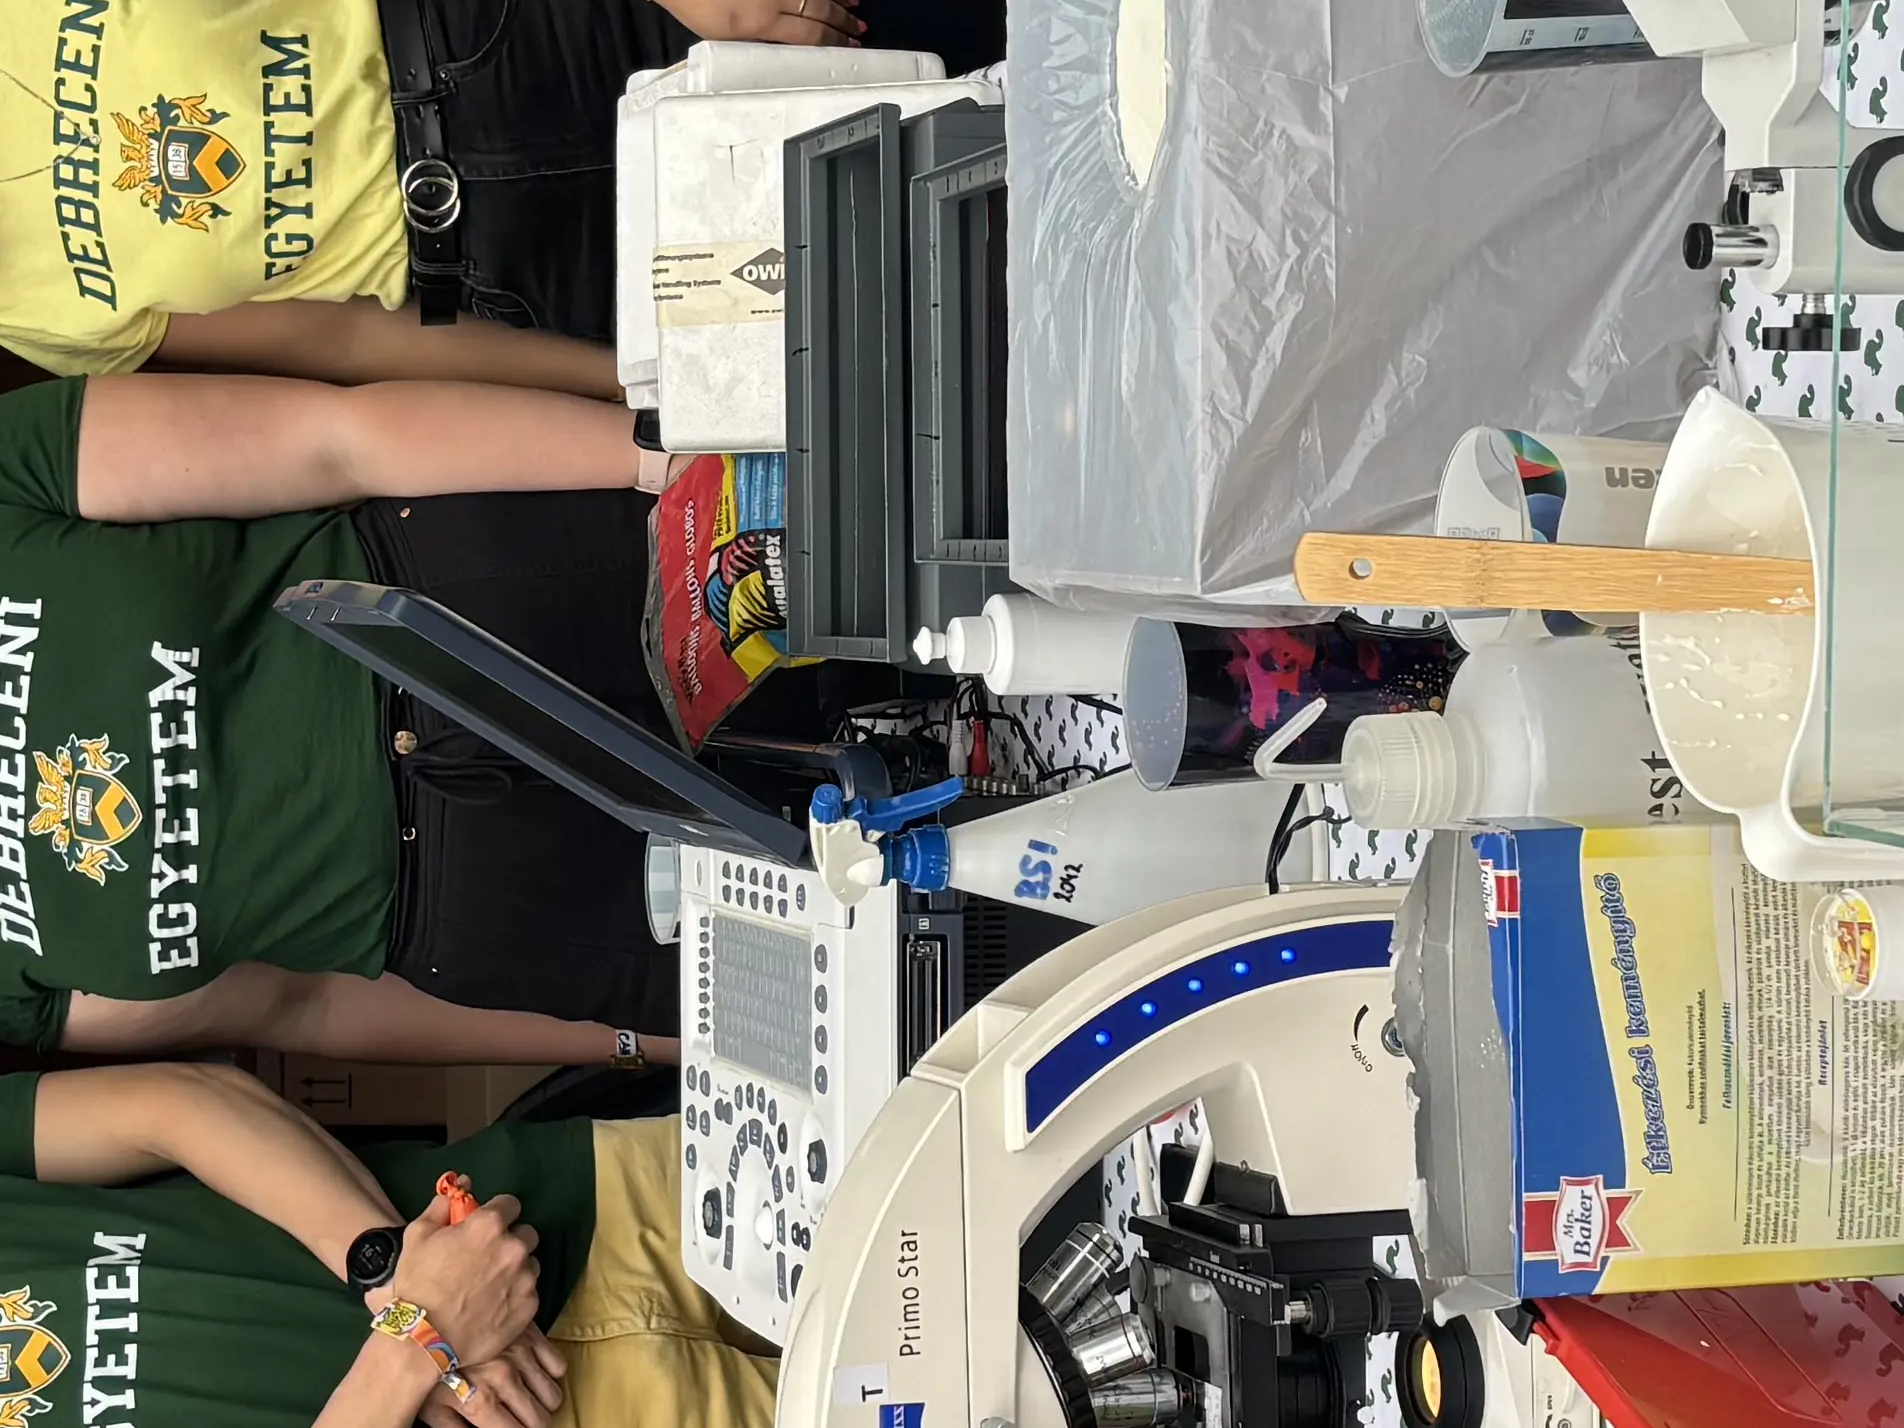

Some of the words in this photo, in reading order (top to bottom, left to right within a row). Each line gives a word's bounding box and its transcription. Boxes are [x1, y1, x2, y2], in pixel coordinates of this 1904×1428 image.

[260, 29, 315, 280] EGYETEM
[148, 641, 200, 974] EGYETEM
[1593, 872, 1650, 1038] keményítő
[1626, 1046, 1673, 1174] Étkezési
[896, 1229, 919, 1278] Star
[1561, 1208, 1576, 1239] Mrs.
[1572, 1188, 1595, 1257] Baker
[897, 1286, 922, 1357] Primo
[861, 1384, 884, 1402] T
